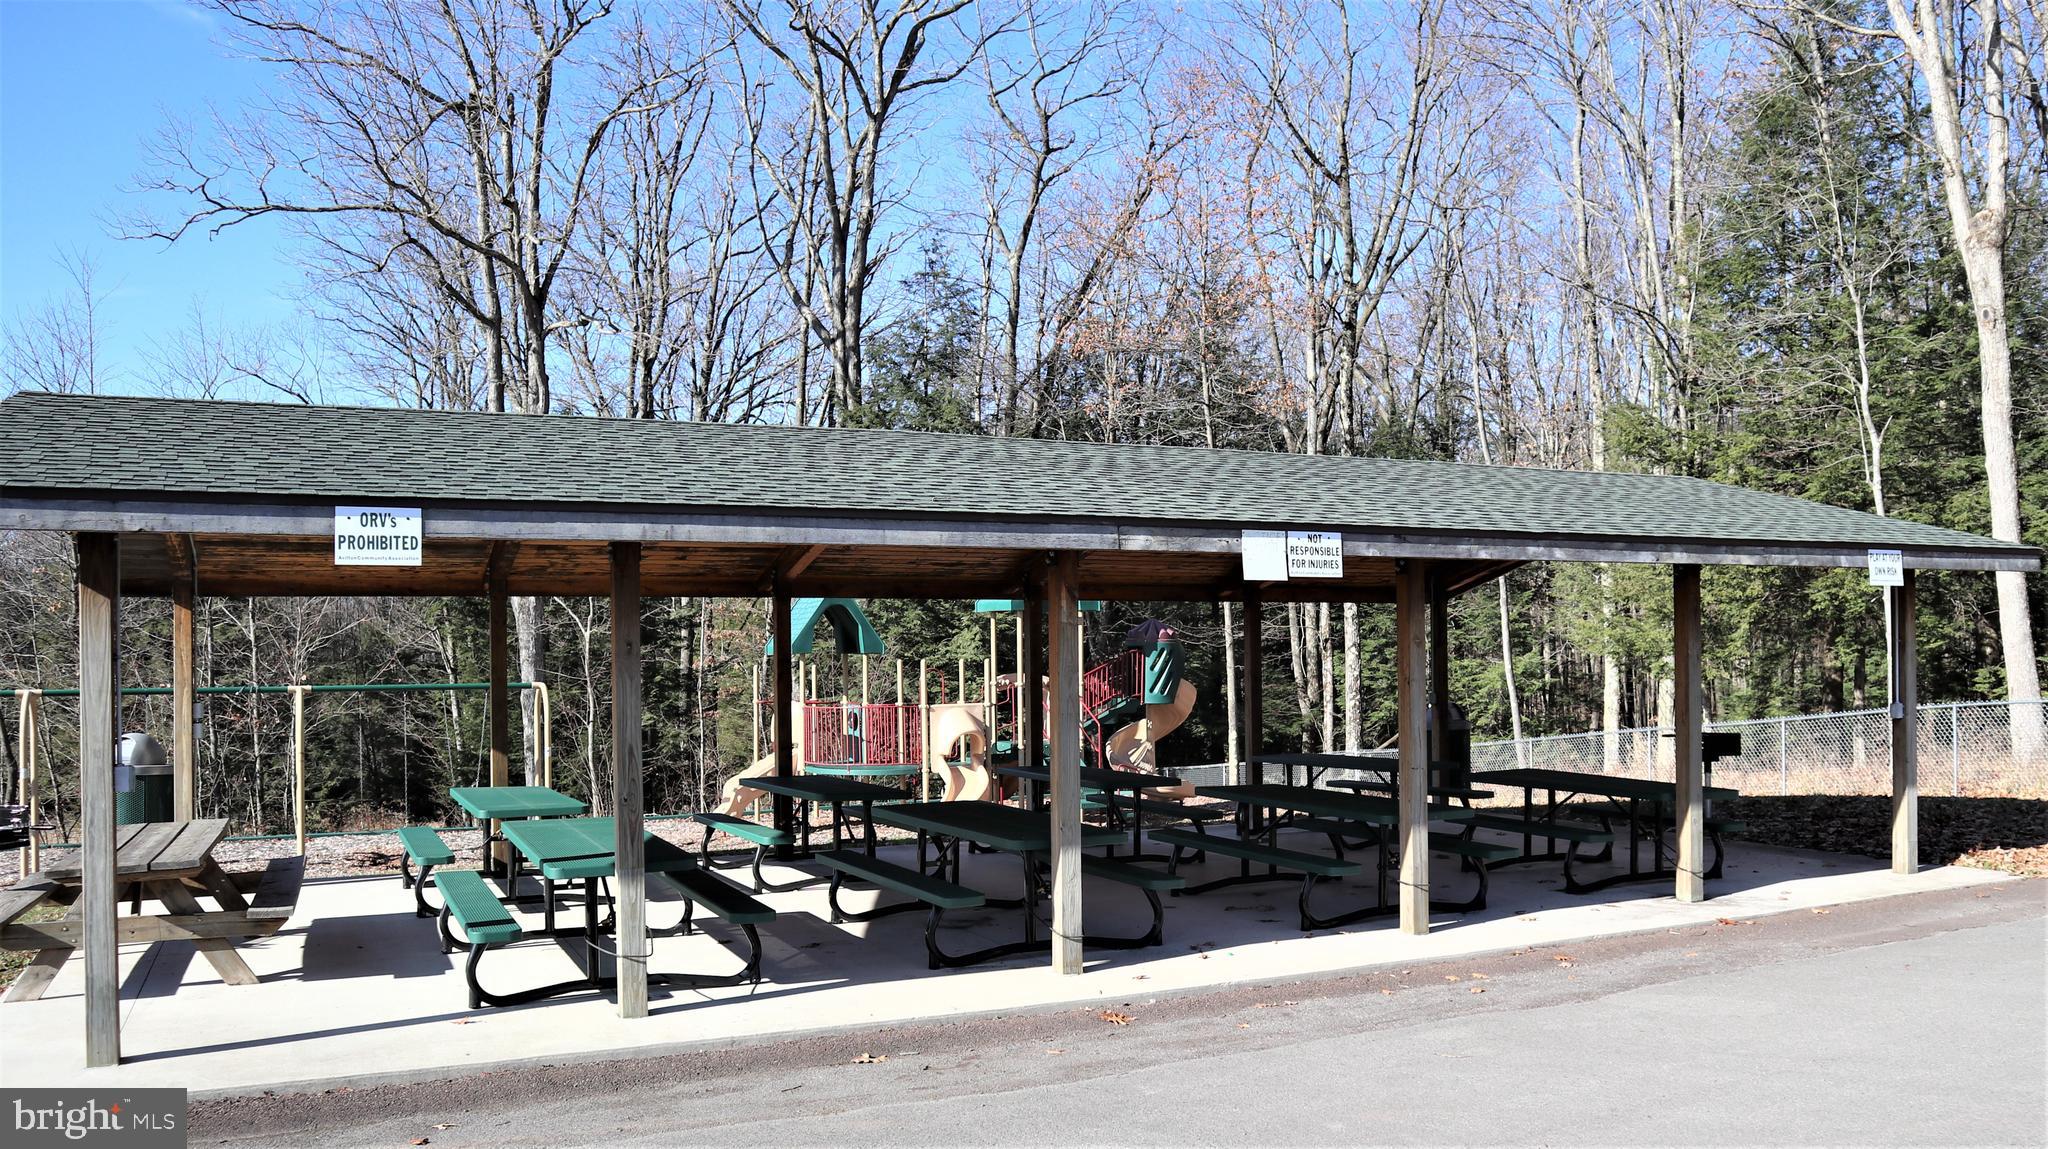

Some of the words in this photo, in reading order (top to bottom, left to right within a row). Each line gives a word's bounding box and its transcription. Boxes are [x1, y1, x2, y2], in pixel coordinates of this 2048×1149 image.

[360, 512, 397, 527] ORV's
[338, 535, 419, 550] PROHIBITED
[1307, 534, 1323, 543] NOT
[1290, 546, 1340, 556] RESPONSIBLE
[1291, 559, 1306, 569] FOR
[1308, 560, 1340, 569] INJURIES
